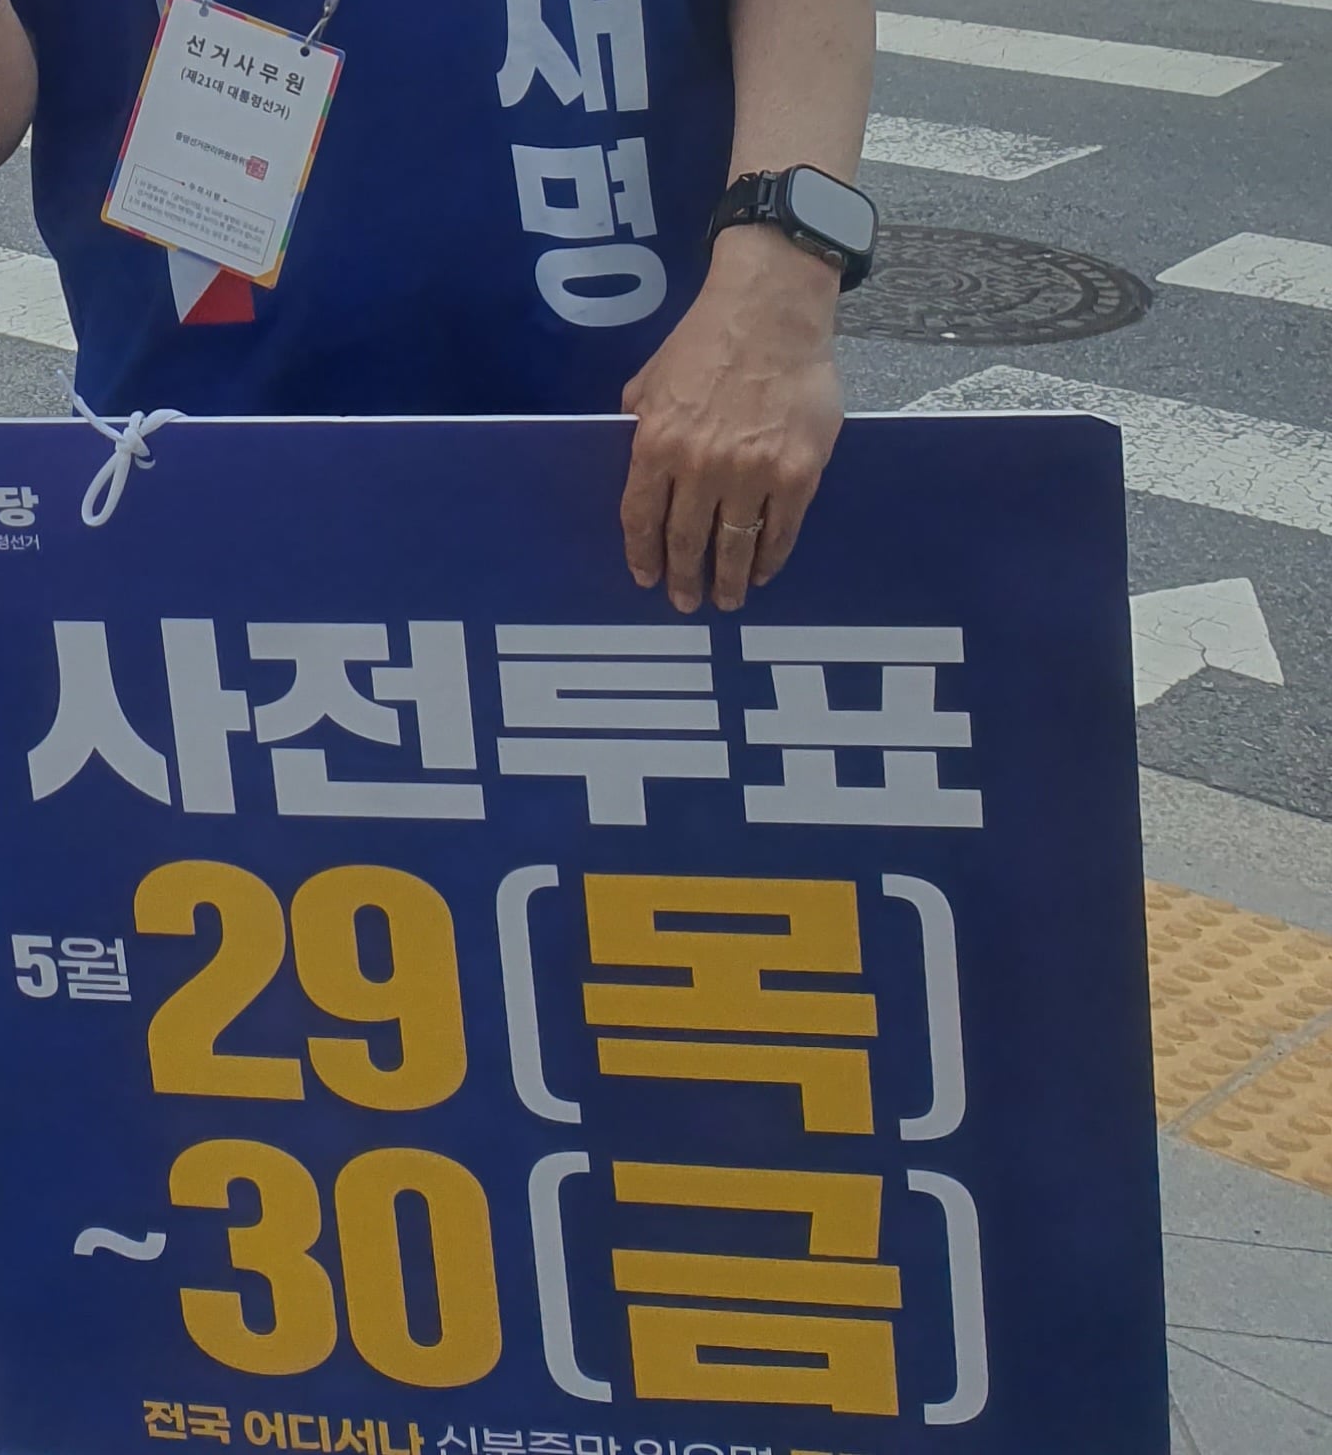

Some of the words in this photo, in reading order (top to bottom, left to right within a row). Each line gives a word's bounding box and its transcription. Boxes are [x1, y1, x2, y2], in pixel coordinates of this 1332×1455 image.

[180, 65, 225, 94] (제21대
[227, 83, 291, 121] 대통령선거)
[27, 617, 984, 828] 사전투표
[10, 932, 134, 1002] 5월
[132, 859, 967, 1143] 29(목)
[143, 1400, 231, 1444] 전국
[243, 1410, 425, 1455] 어디서나
